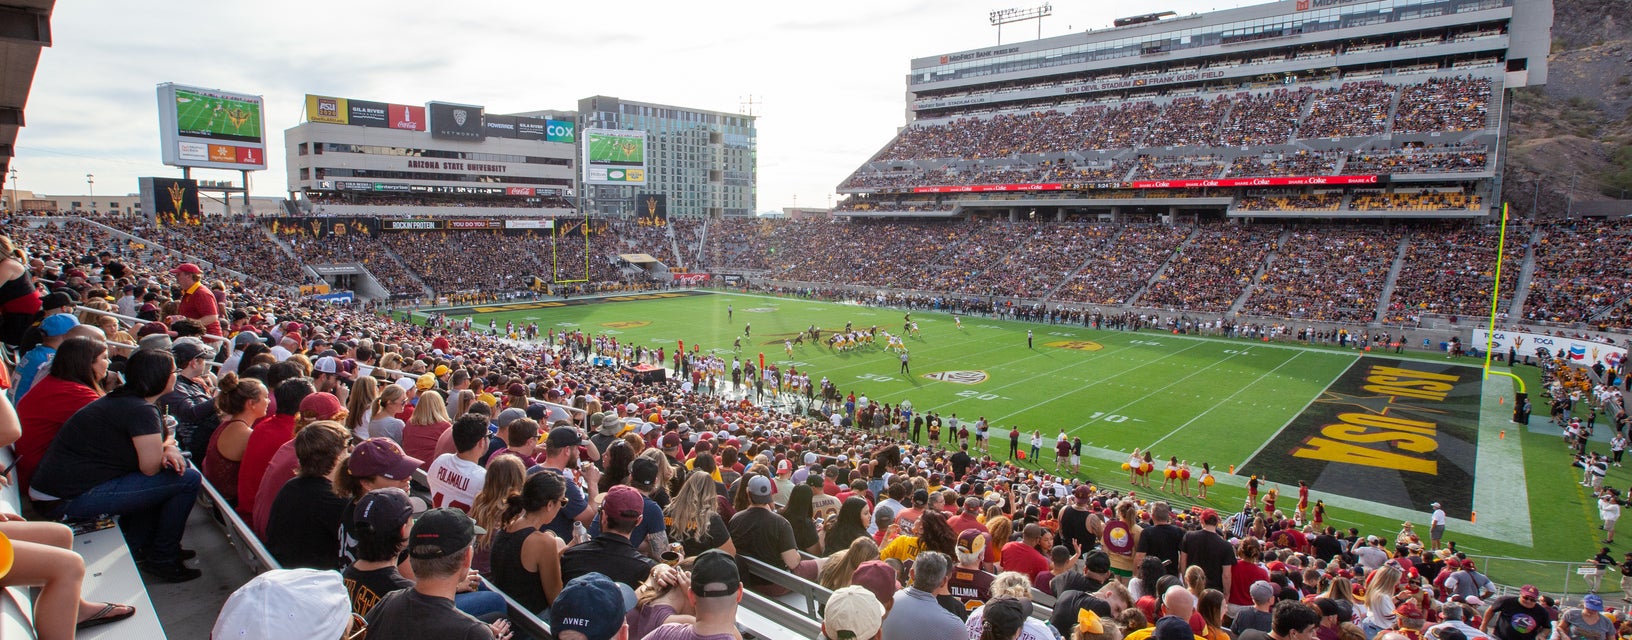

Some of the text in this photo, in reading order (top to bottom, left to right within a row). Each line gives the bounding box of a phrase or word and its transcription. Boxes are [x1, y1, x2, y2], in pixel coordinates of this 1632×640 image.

[1101, 80, 1131, 90] STADIUM
[1149, 76, 1175, 85] FRANK
[1176, 74, 1199, 82] KUSH
[1201, 71, 1225, 79] FIELD
[487, 122, 515, 130] POWERADE
[547, 124, 574, 137] COX
[441, 130, 480, 138] NETWORKS
[408, 159, 507, 173] ARIZONA STATE UNIVERSITY
[1533, 337, 1554, 346] TOCA
[955, 390, 999, 400] 20
[1089, 411, 1129, 423] 10
[1289, 364, 1461, 476] ASU USA
[437, 465, 471, 492] POLAMALU
[951, 586, 978, 598] TILLMAN
[562, 617, 590, 627] AVNET
